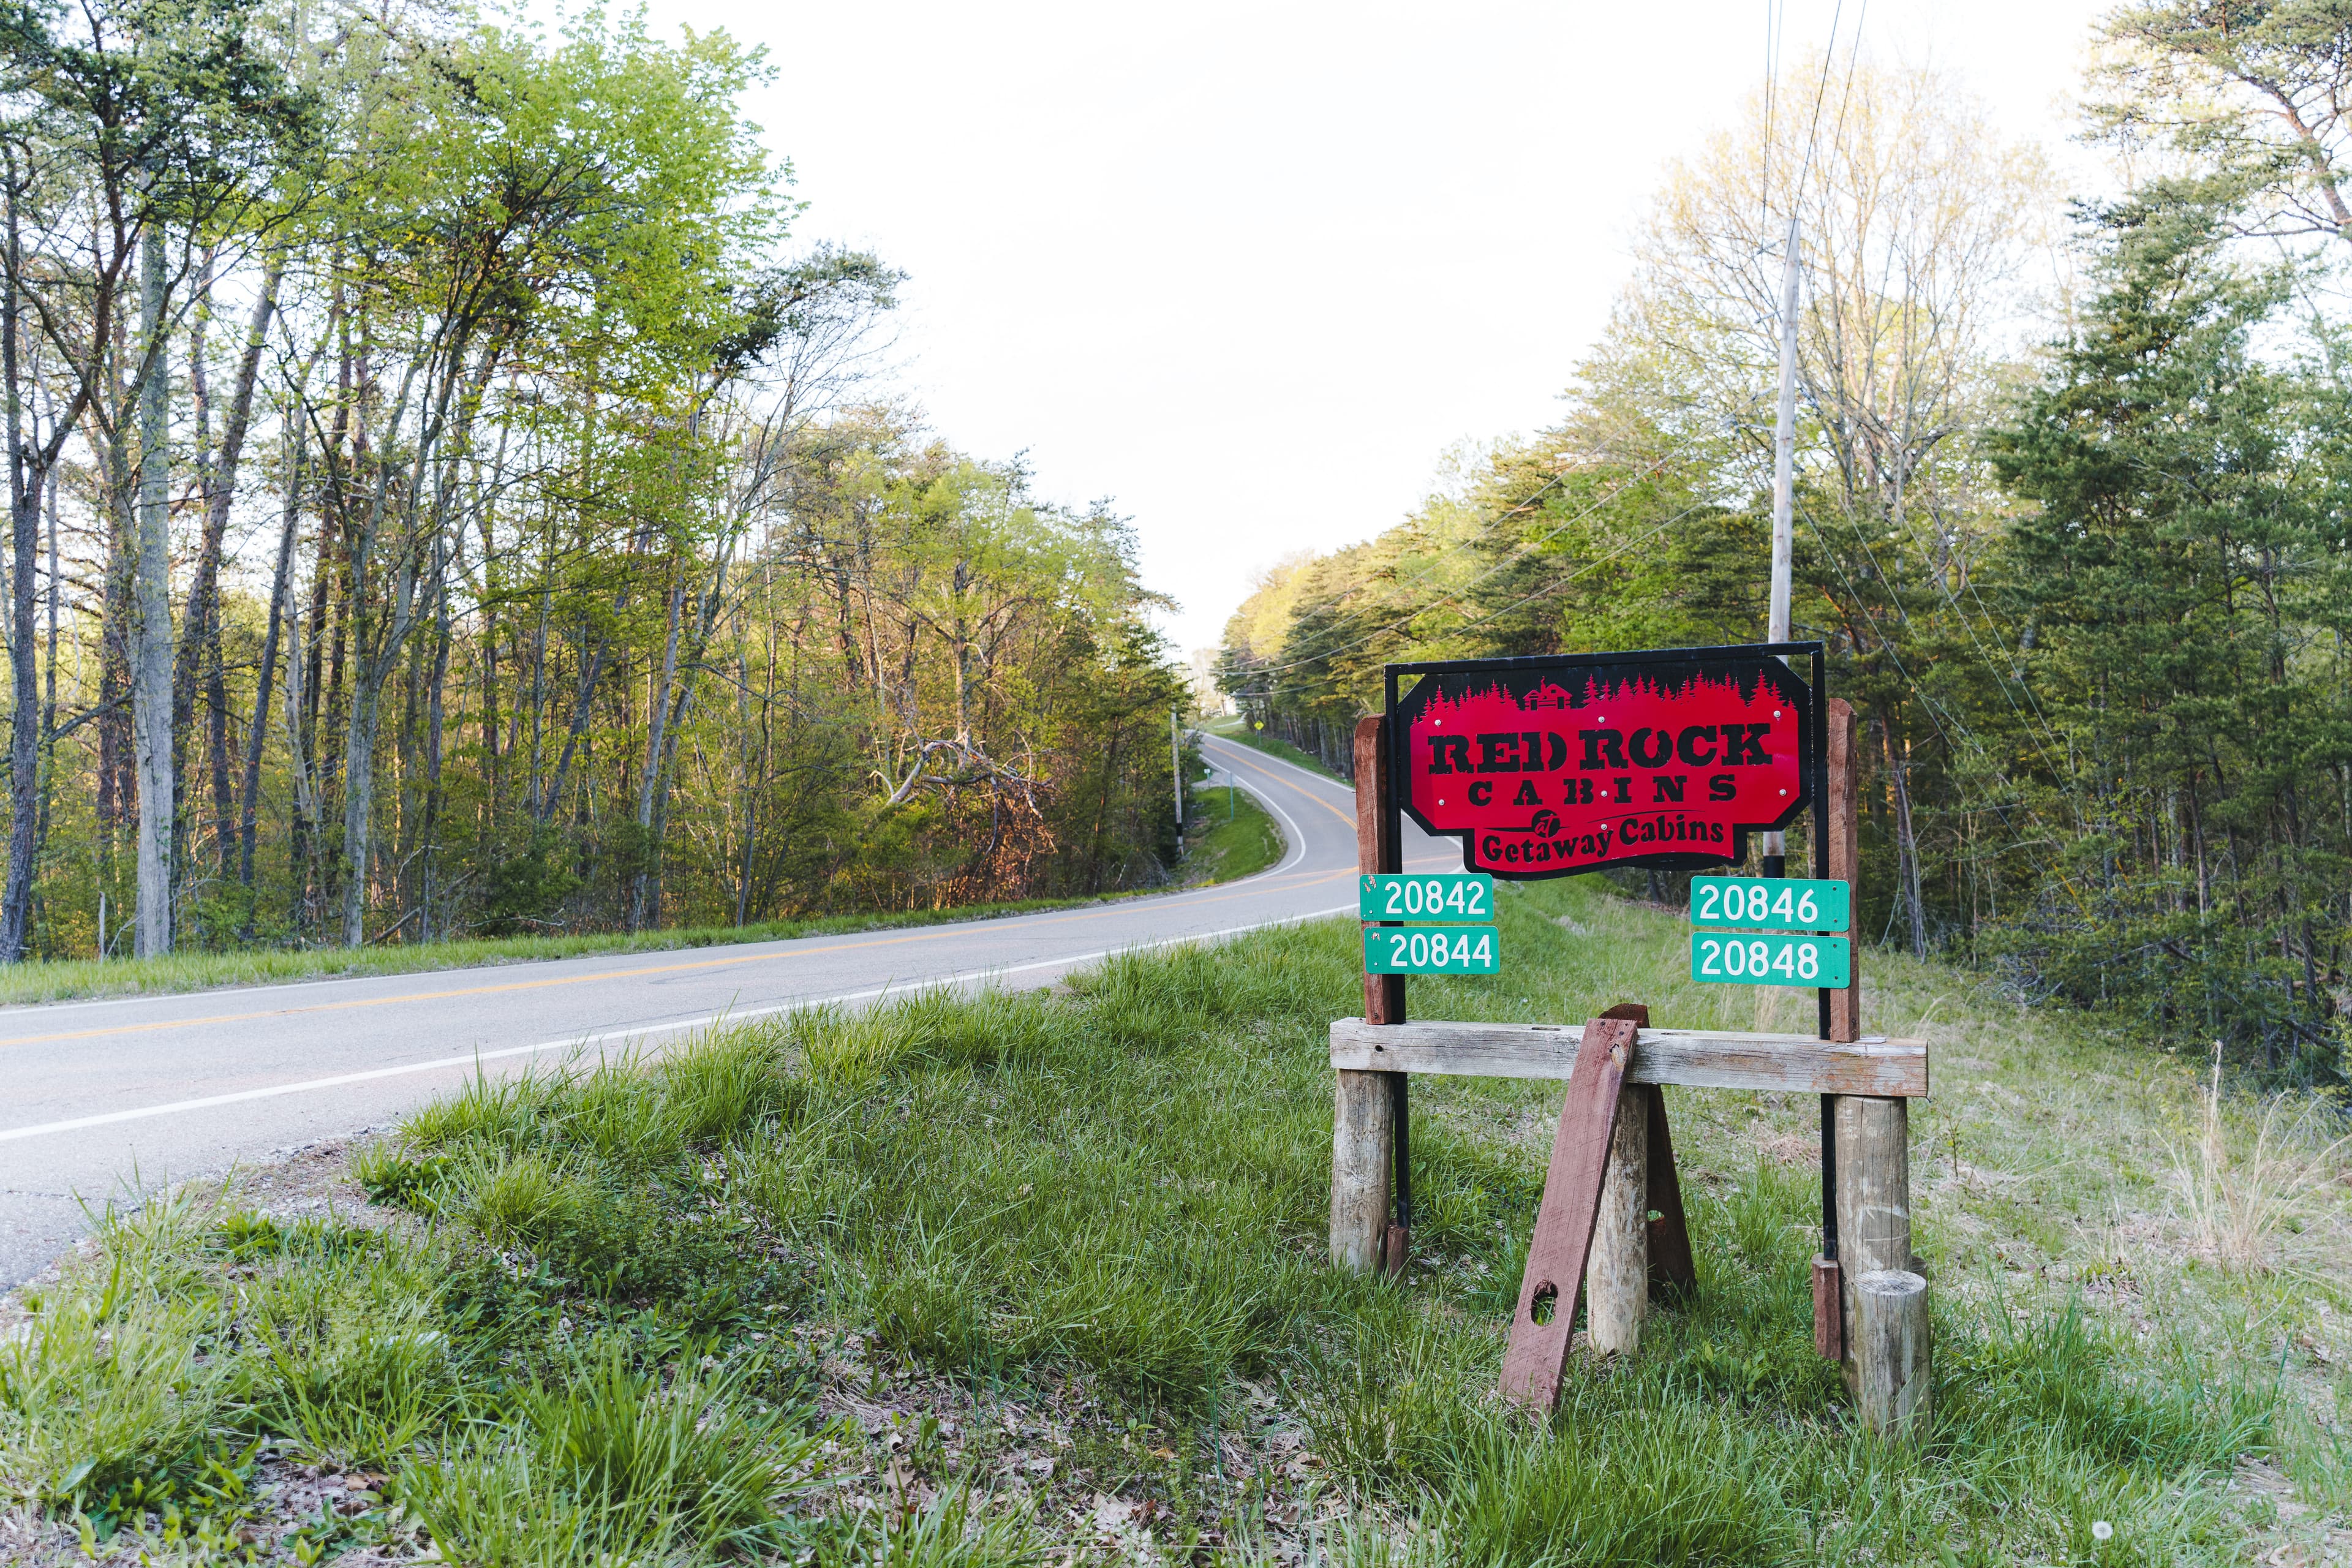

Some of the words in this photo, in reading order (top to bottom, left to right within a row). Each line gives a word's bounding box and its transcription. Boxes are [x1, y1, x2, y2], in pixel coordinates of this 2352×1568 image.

[1427, 731, 1567, 775] RED
[1578, 723, 1773, 771] ROCK
[1468, 774, 1737, 807] CABINS
[1482, 829, 1614, 863] Getaway
[1619, 814, 1724, 846] Cabins
[1534, 813, 1559, 838] at
[1385, 880, 1485, 914] 20842
[1699, 884, 1818, 923] 20846
[1390, 933, 1492, 967] 20844
[1701, 940, 1819, 979] 20848
